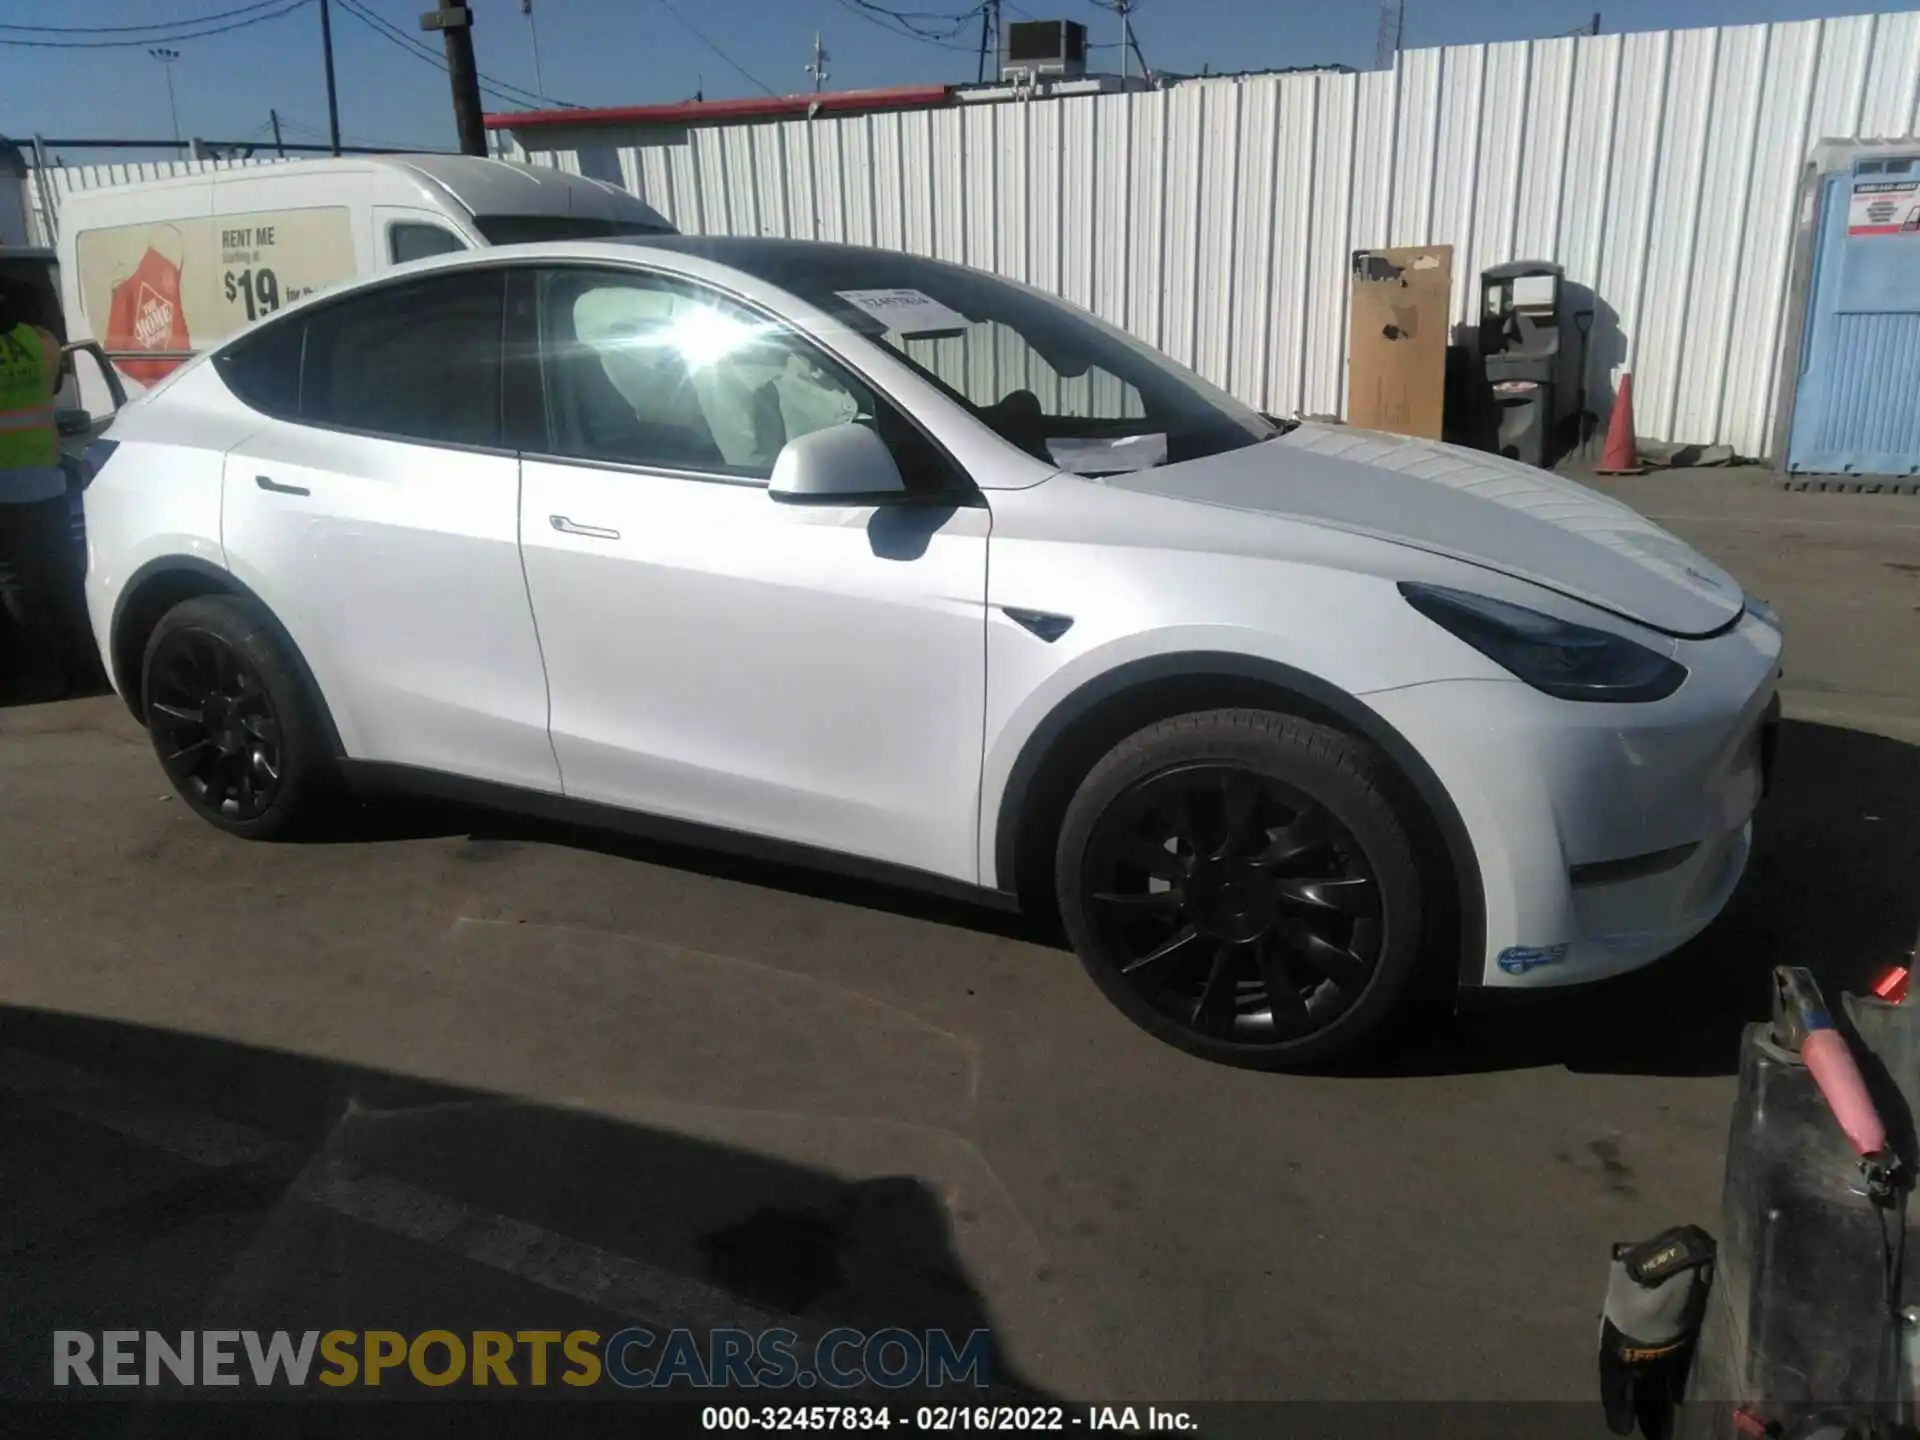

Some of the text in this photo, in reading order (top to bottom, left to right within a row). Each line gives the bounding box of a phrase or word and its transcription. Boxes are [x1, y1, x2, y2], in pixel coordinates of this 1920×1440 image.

[222, 226, 275, 248] RENT ME
[224, 268, 280, 321] $19
